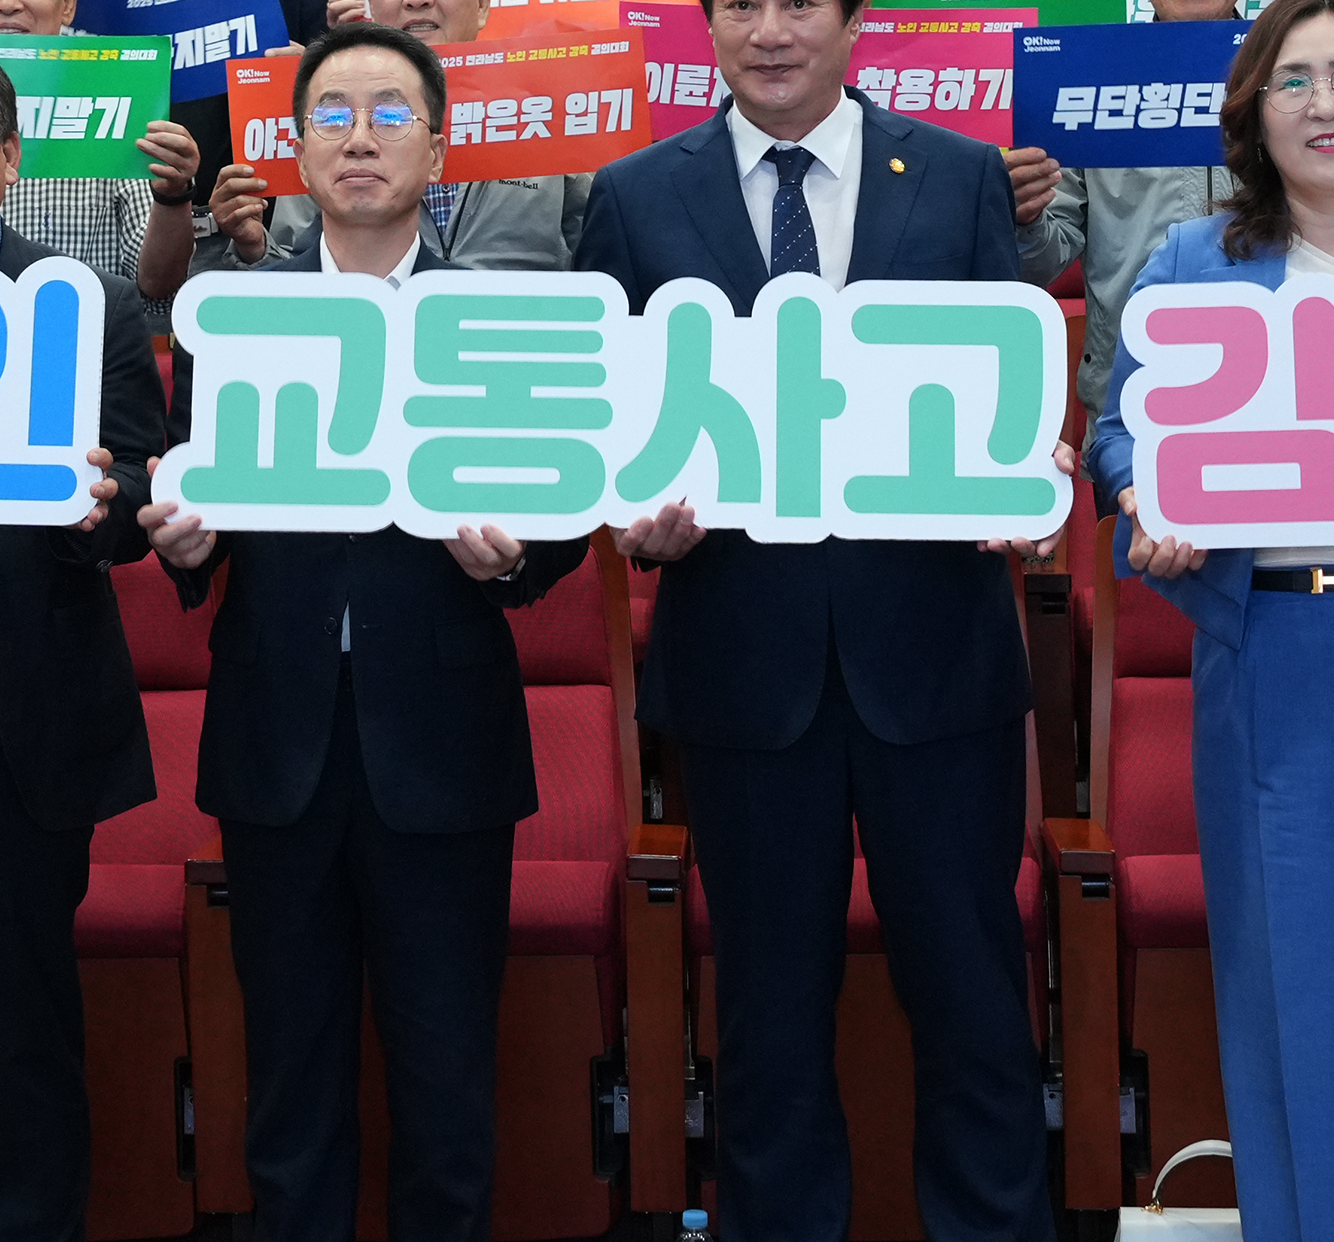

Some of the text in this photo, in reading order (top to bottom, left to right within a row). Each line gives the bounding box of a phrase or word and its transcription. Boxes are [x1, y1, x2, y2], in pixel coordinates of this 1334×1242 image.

[171, 14, 258, 70] 지말기
[897, 23, 917, 32] 노인
[916, 22, 958, 32] 교통사고
[961, 22, 981, 32] 감축
[983, 22, 1023, 32] 결의대회
[1024, 37, 1060, 49] OK! Now
[466, 53, 504, 65] 전라남도
[507, 51, 526, 62] 노인
[529, 48, 566, 60] 교통사고
[569, 45, 588, 57] 감축
[591, 41, 629, 55] 결의대회
[1024, 43, 1060, 52] Jeonnam
[858, 68, 1012, 111] 착용하기
[450, 88, 633, 146] 밝은옷 입기
[1052, 84, 1224, 131] 무단횡단
[497, 177, 541, 192] mont-bell
[180, 294, 1059, 518] 교통사고
